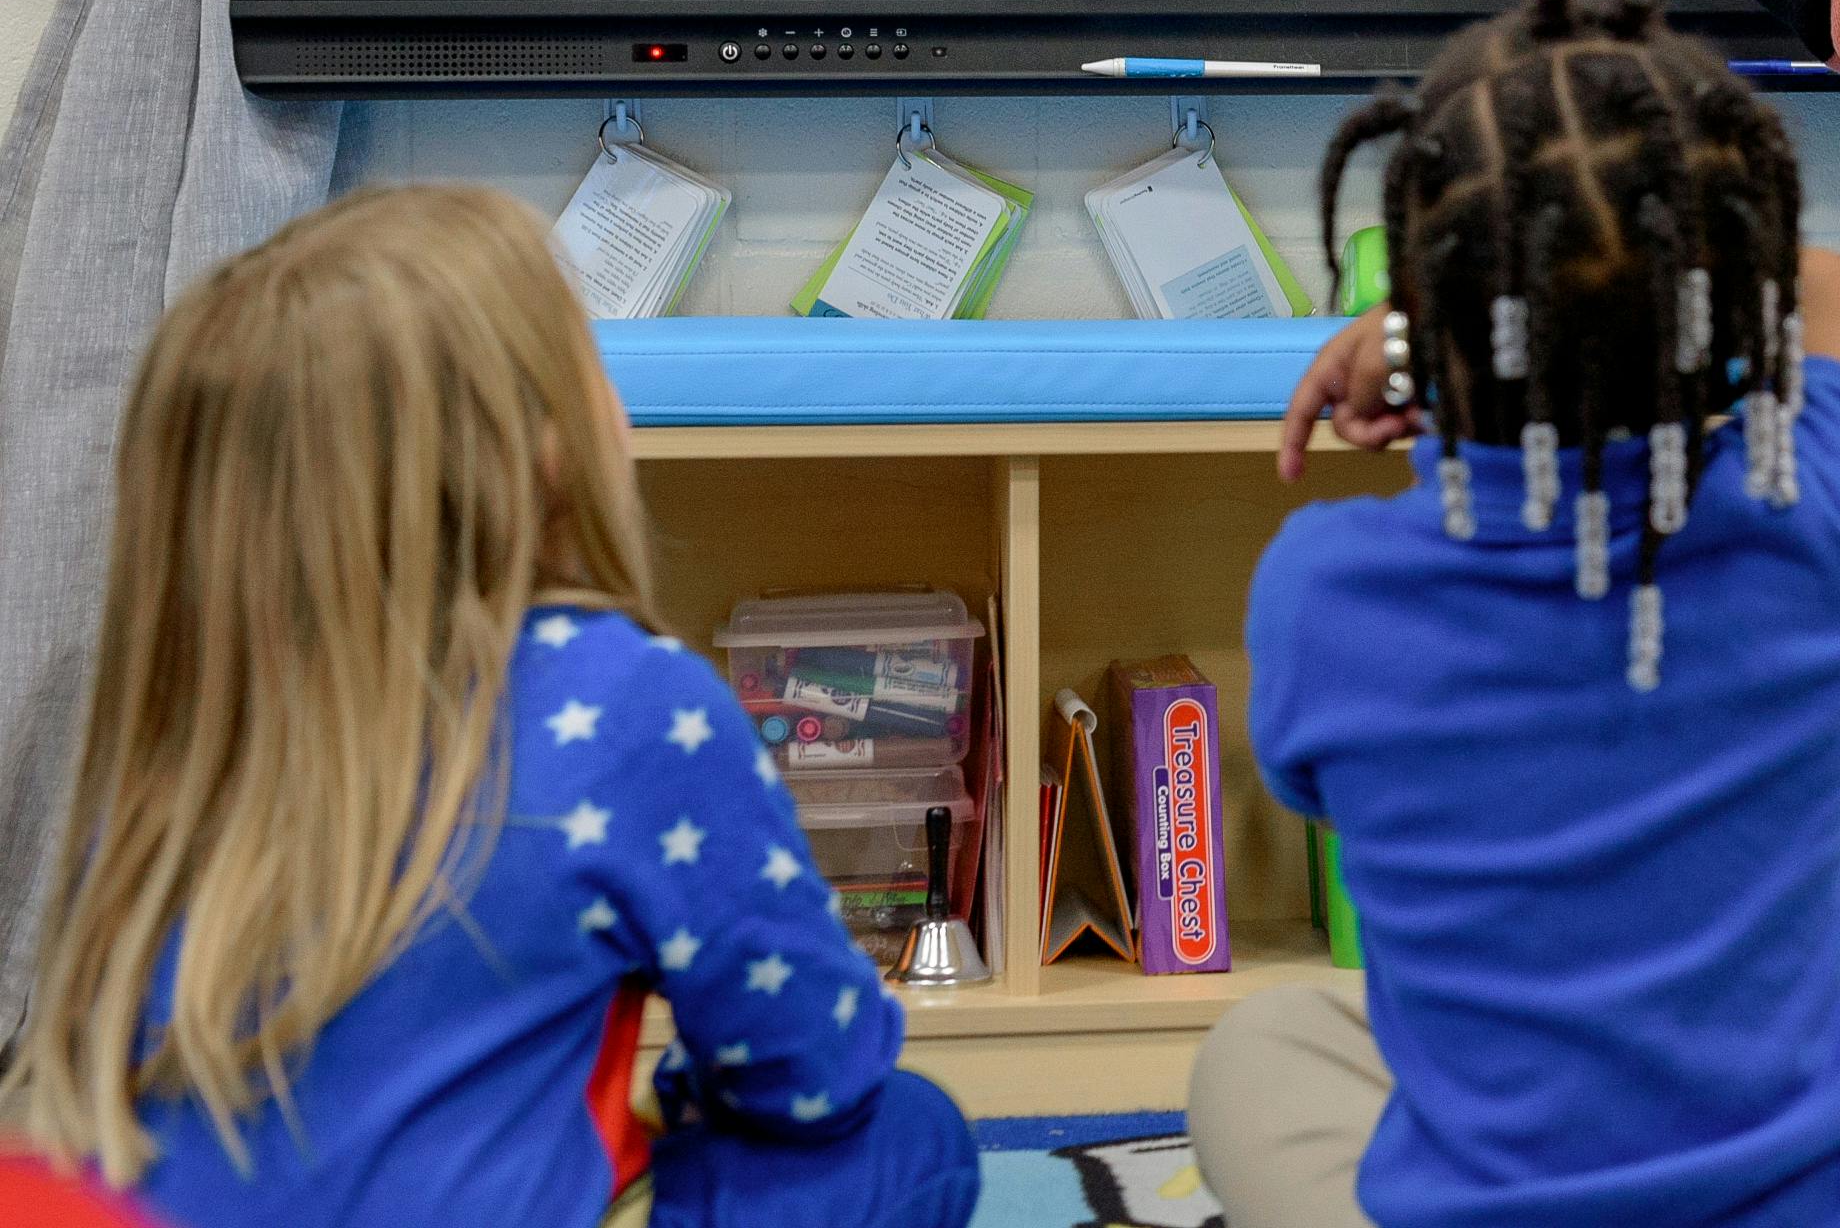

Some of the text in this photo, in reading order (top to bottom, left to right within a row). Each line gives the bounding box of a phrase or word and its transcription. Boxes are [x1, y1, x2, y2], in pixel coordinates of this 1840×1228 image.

[1157, 785, 1172, 881] Counting Box
[1173, 721, 1206, 943] Treasure Chest
